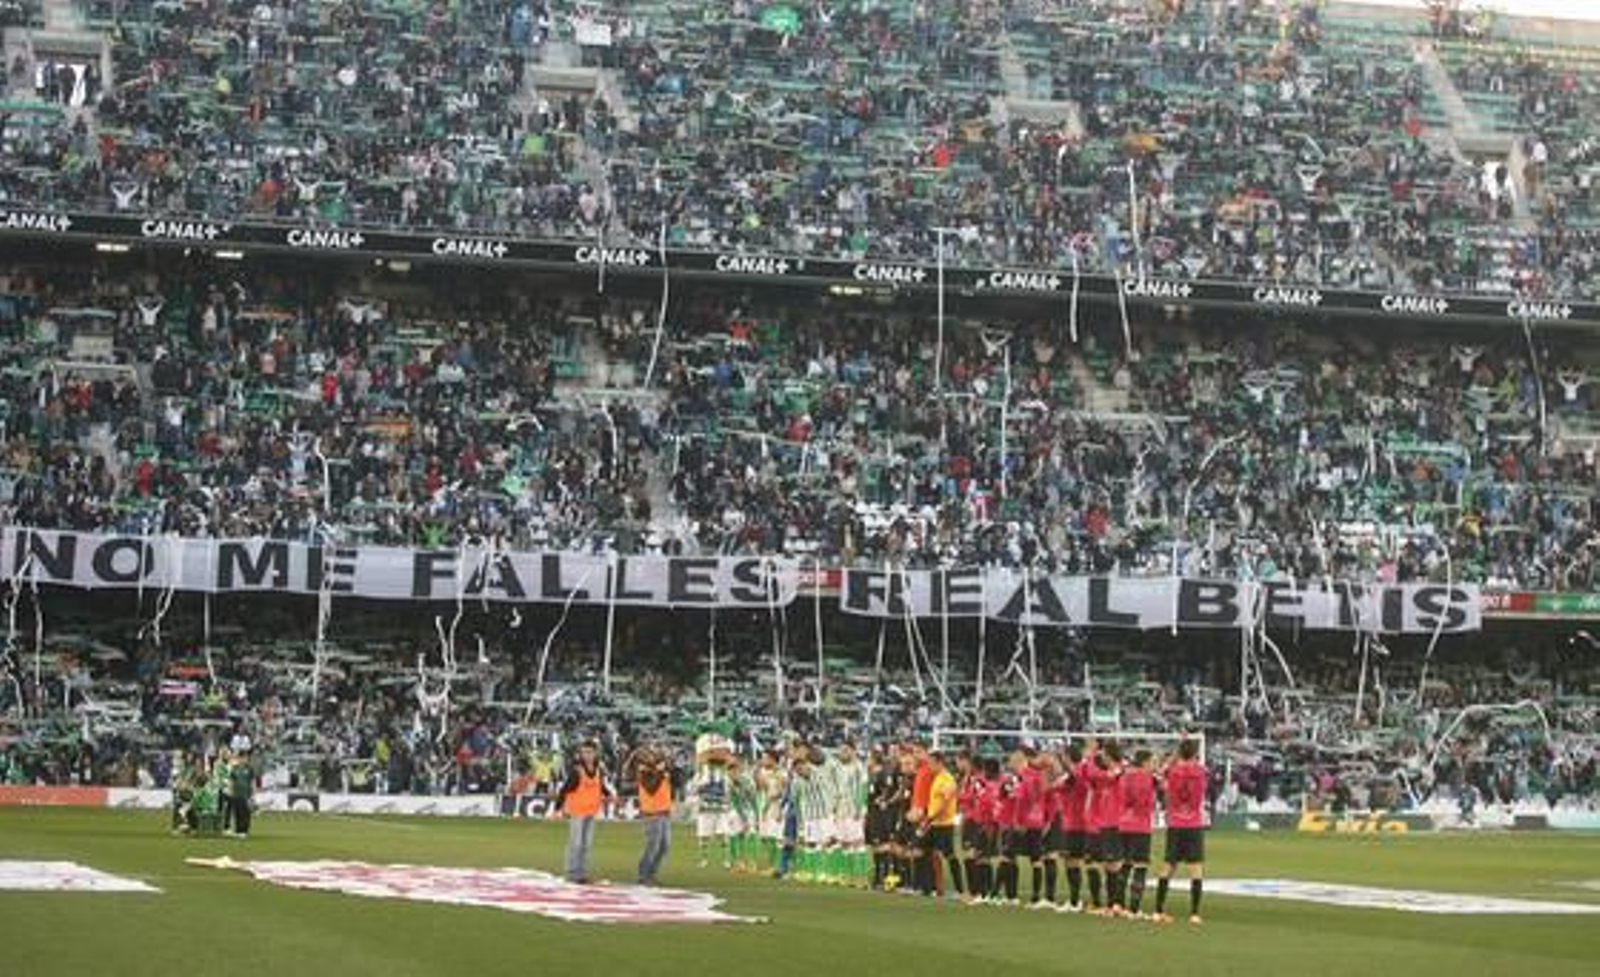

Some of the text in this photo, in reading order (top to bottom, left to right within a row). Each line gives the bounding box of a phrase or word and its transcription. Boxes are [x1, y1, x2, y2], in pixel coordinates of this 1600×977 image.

[141, 220, 218, 240] CANAL+
[287, 229, 365, 249] CANAL+
[432, 237, 508, 258] CANAL+
[575, 246, 650, 267] CANAL+
[715, 254, 789, 275] CANAL+
[852, 263, 926, 283] CANAL+
[989, 271, 1061, 291] CANAL+
[1123, 278, 1192, 298] CANAL+
[1253, 287, 1322, 307] CANAL+
[1381, 294, 1448, 315] CANAL+
[1506, 301, 1572, 320] CANAL+
[13, 530, 782, 603] NO ME FALLES
[846, 568, 1470, 631] REAL BETIS
